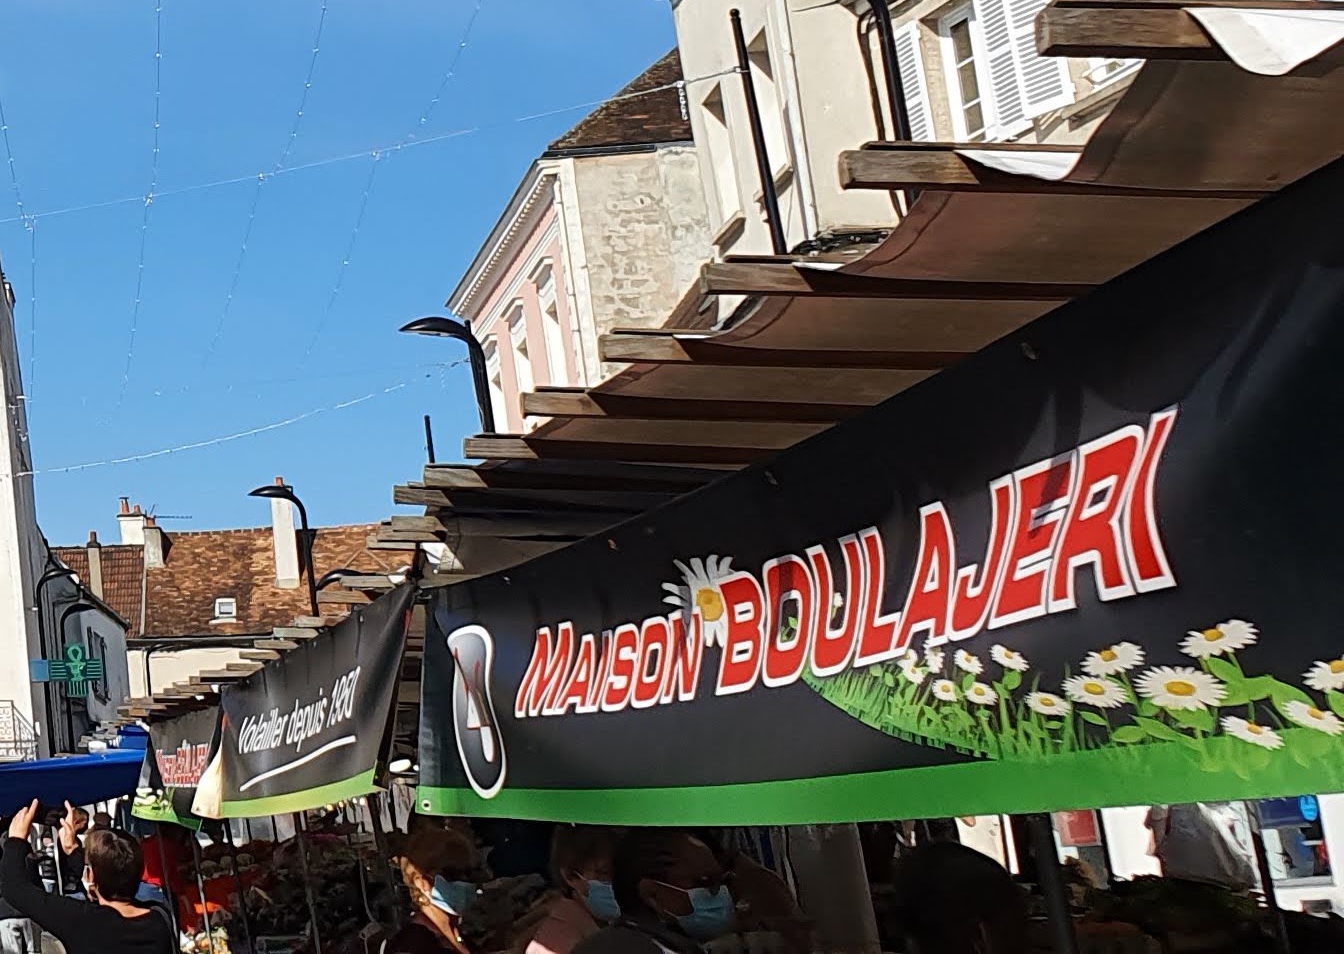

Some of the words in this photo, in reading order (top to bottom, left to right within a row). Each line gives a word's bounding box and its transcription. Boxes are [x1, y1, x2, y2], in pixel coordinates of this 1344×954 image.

[514, 610, 705, 718] MAISON
[715, 404, 1179, 696] BOULAJERI
[238, 706, 289, 755] Volailler
[285, 688, 328, 753] depuis
